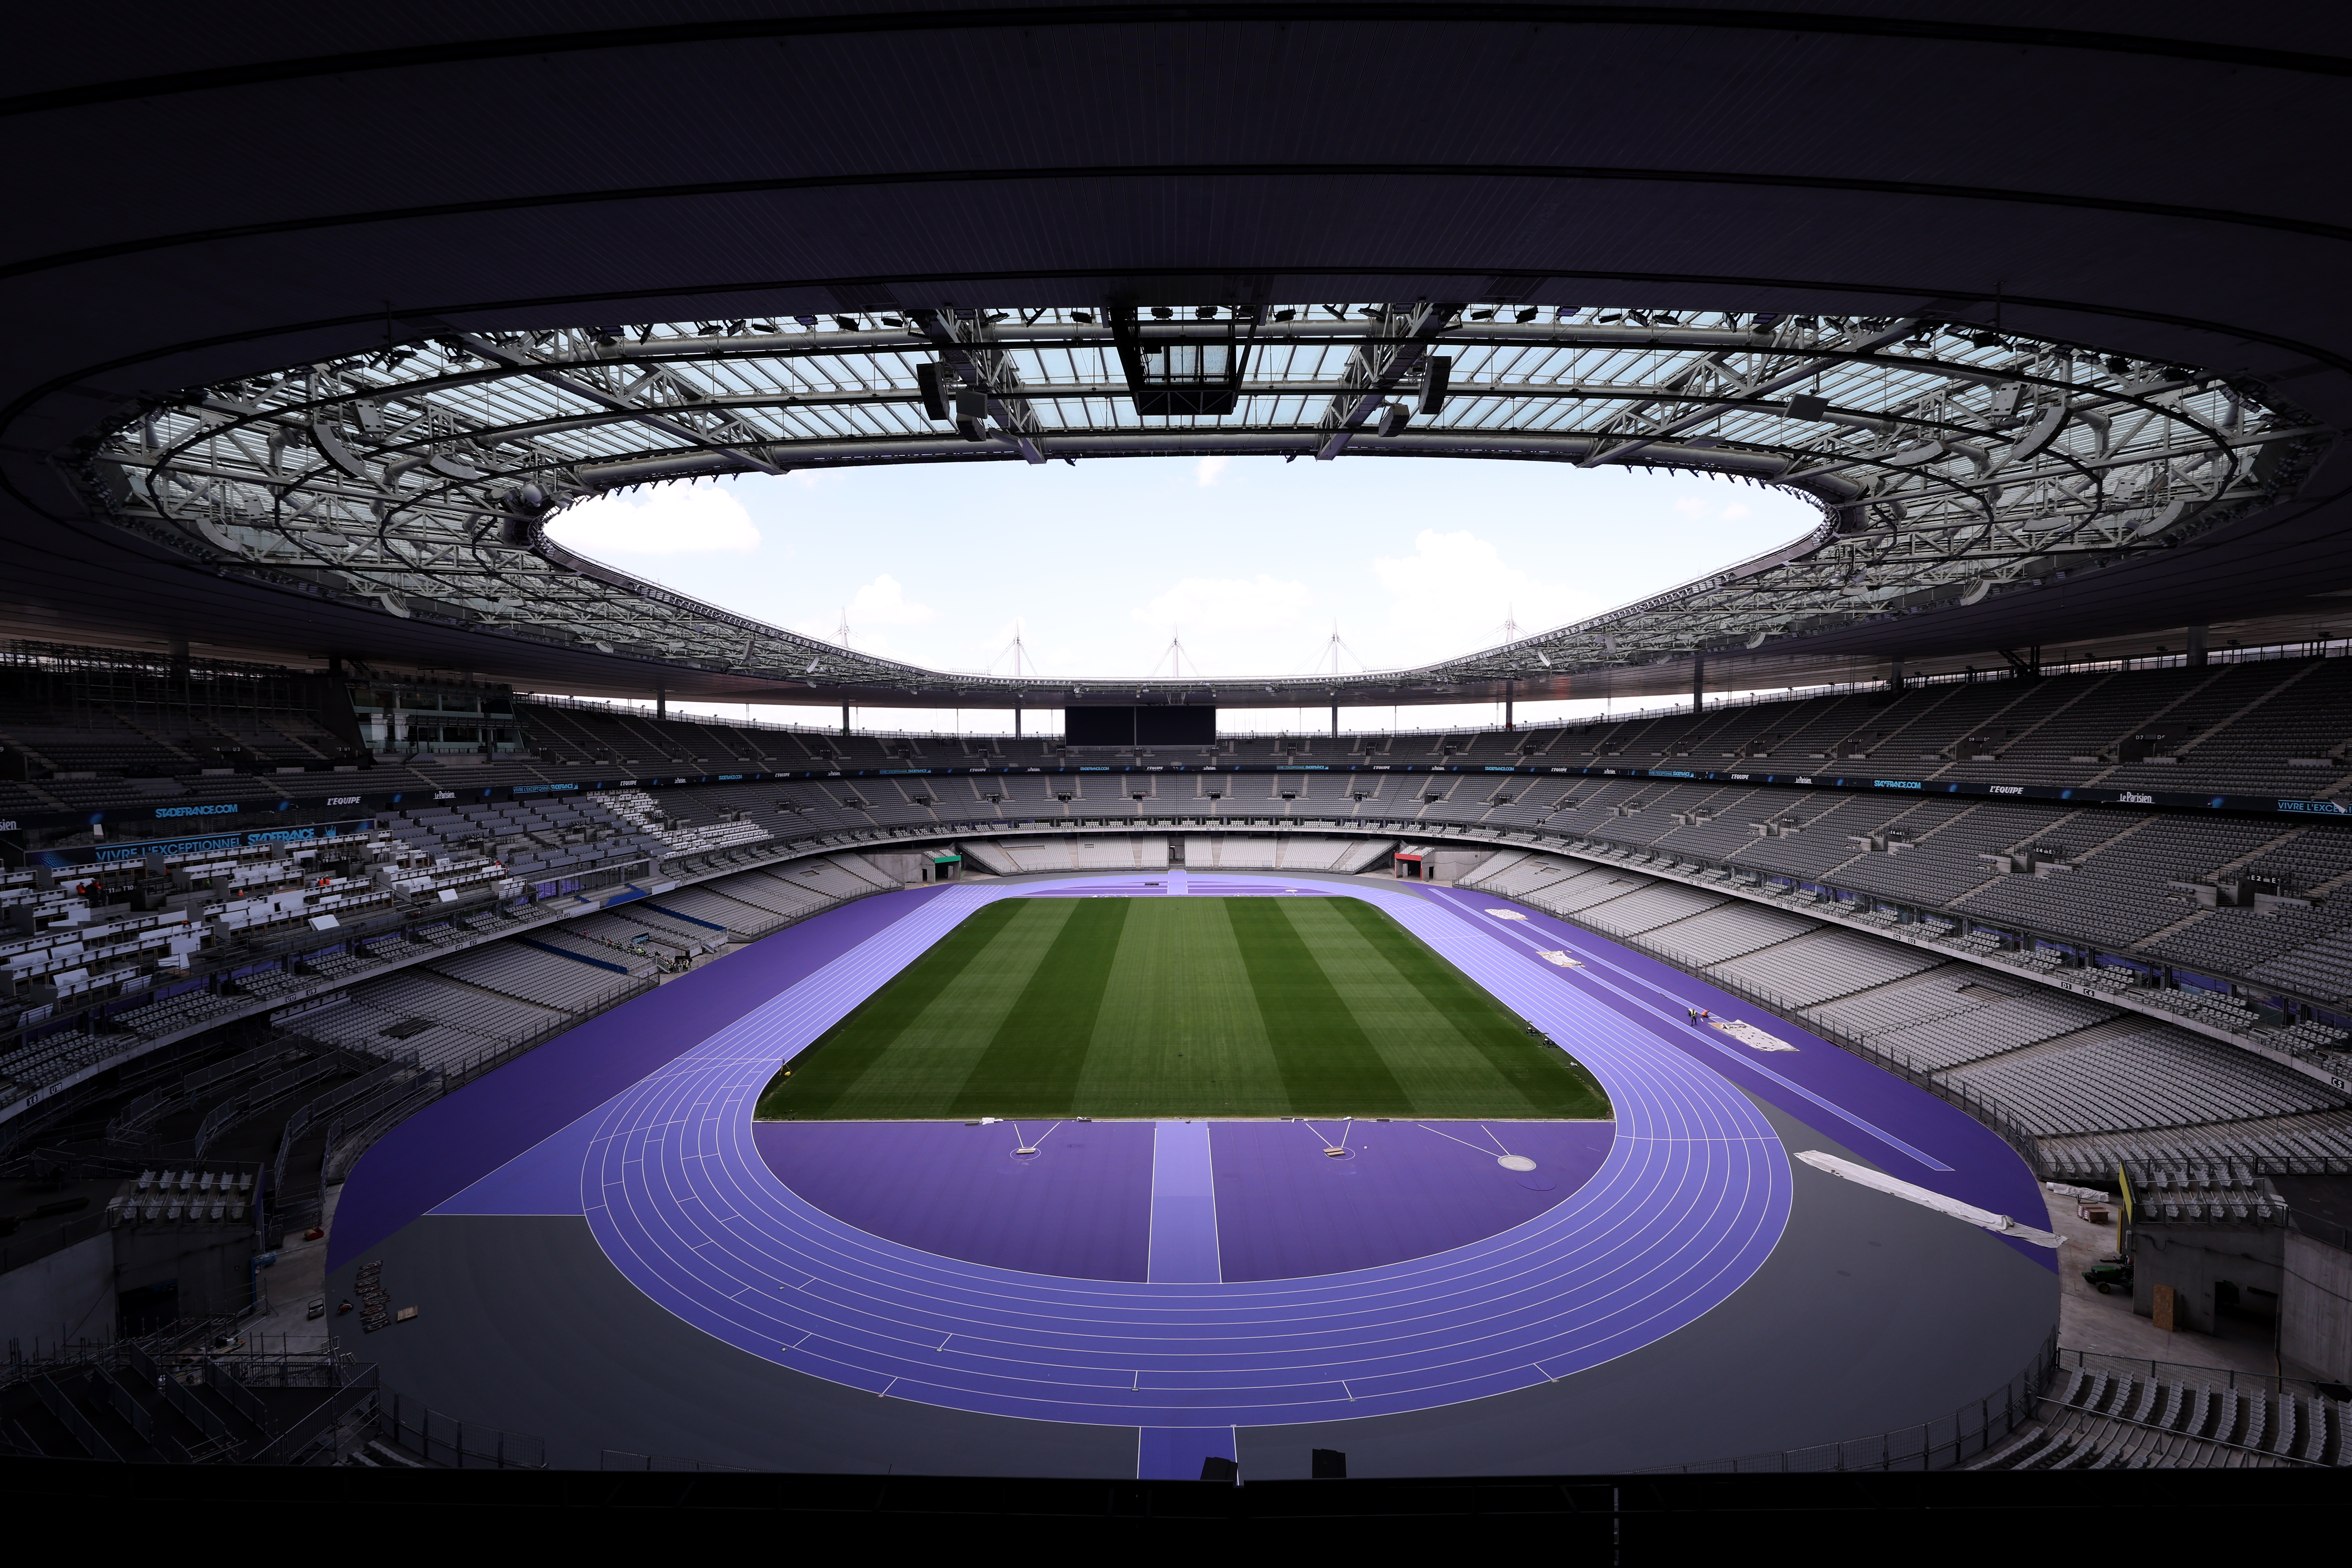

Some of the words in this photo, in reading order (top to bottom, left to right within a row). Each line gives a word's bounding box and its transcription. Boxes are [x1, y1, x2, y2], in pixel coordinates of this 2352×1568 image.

[156, 804, 238, 818] STADEFRANCE.COM
[2278, 802, 2304, 810] VIVRE
[96, 848, 137, 861] VIVRE
[51, 1083, 61, 1093] U18
[2332, 1079, 2342, 1087] C5
[29, 1096, 37, 1106] X8
